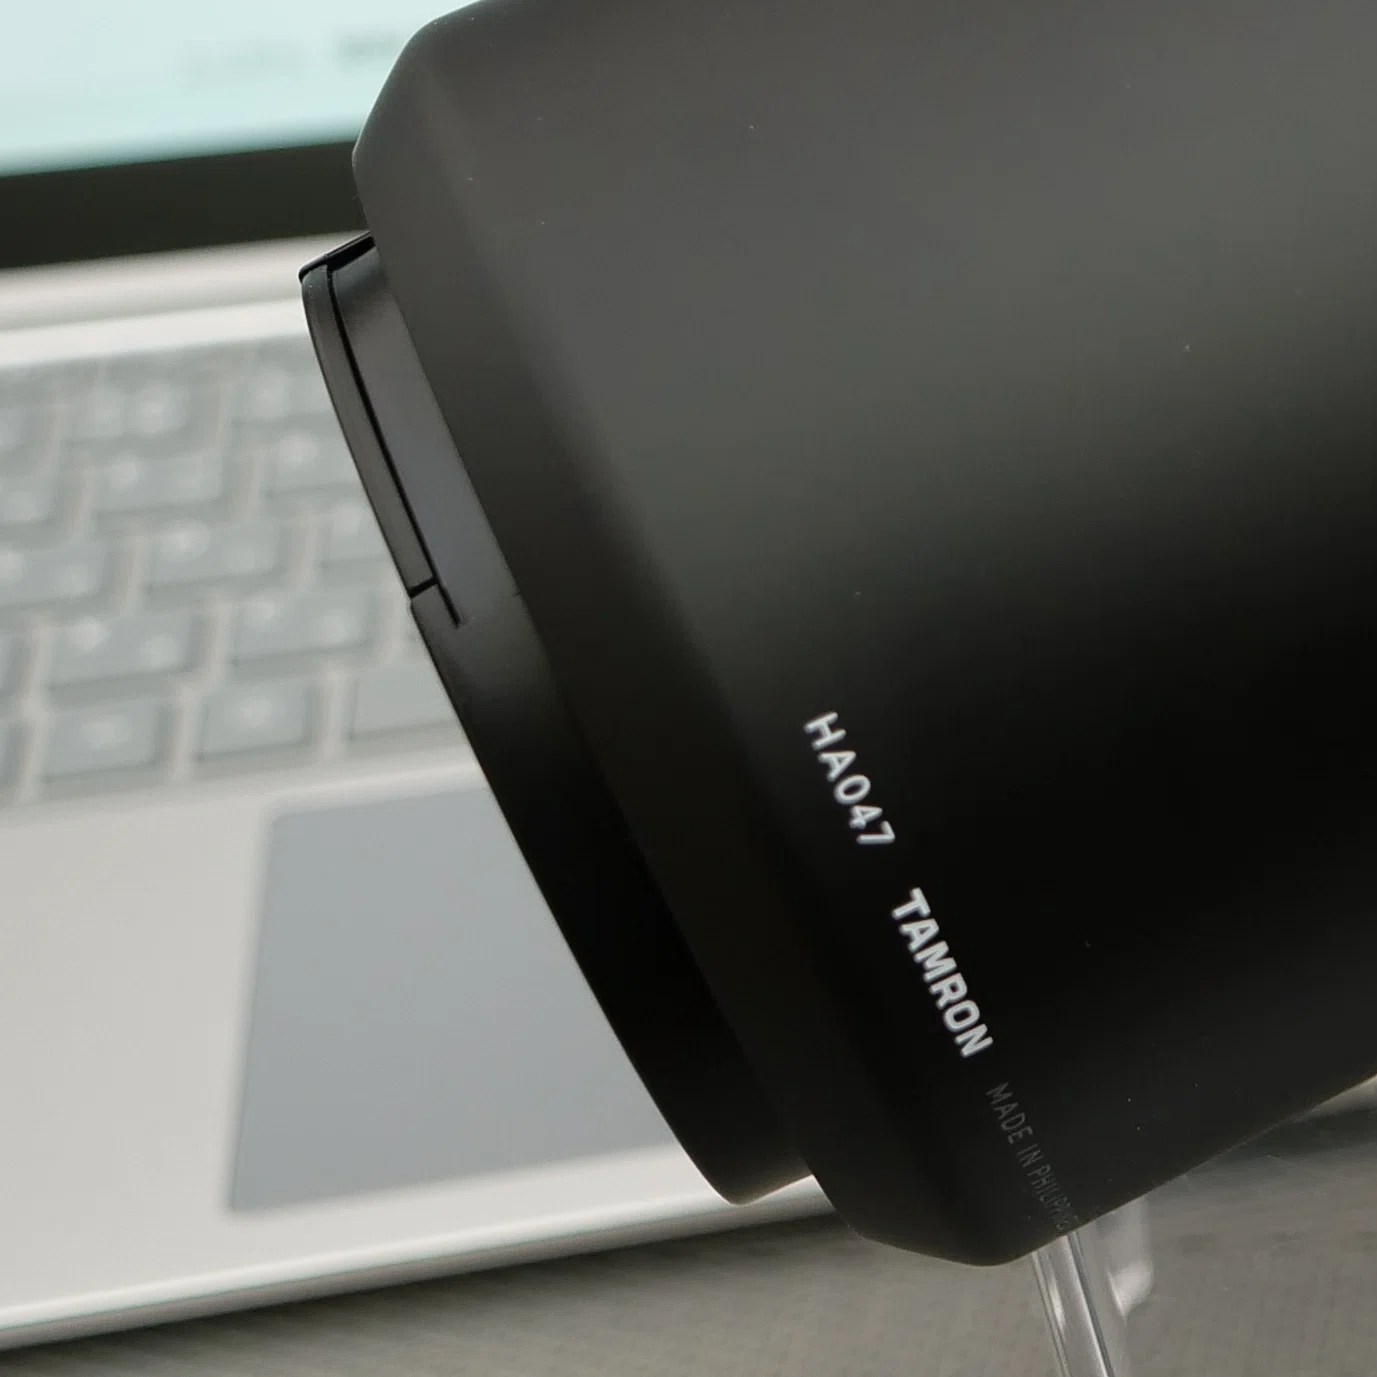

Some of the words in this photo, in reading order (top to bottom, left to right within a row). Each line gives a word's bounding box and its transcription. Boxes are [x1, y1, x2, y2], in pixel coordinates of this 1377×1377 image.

[803, 710, 896, 846] HA047
[891, 887, 994, 1058] TAMRON
[986, 1081, 1034, 1145] MADE
[1017, 1142, 1046, 1174] IN
